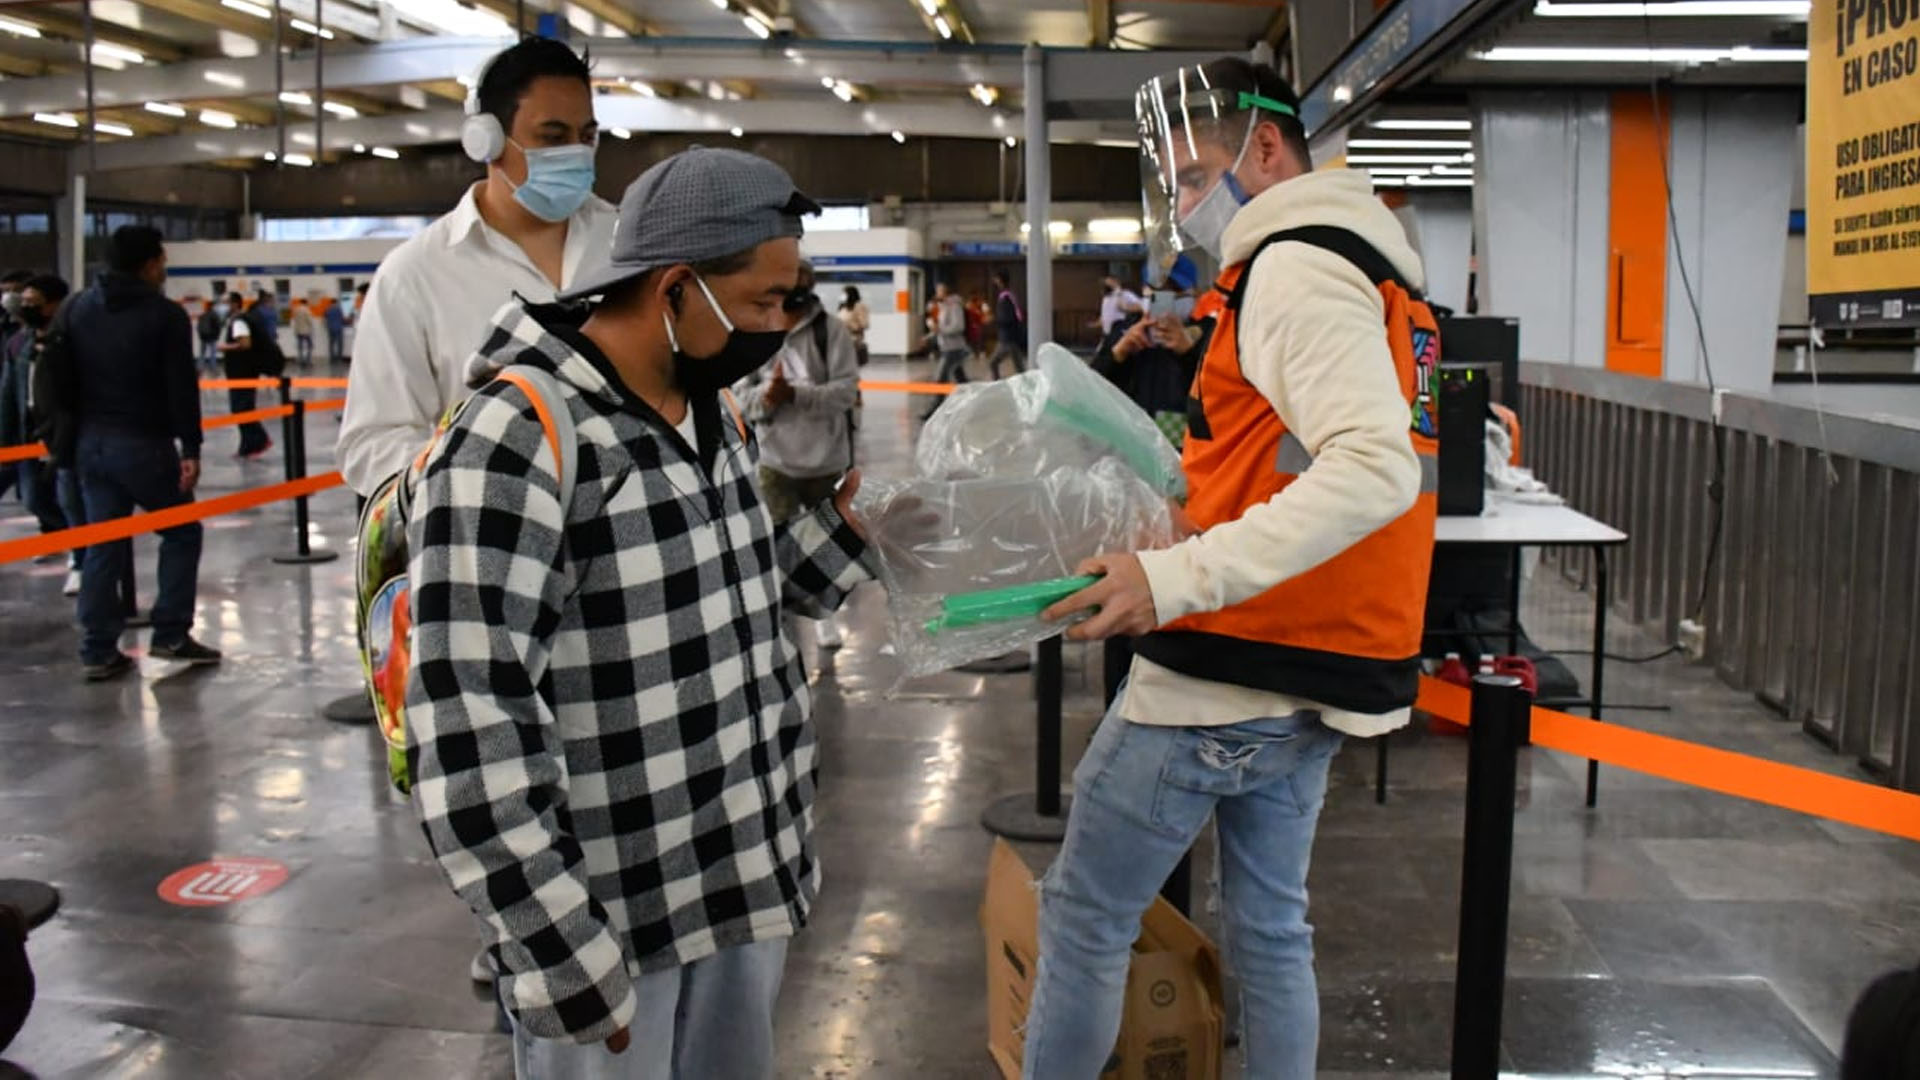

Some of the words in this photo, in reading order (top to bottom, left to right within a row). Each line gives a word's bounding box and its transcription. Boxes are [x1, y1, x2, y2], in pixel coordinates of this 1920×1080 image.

[1844, 55, 1862, 95] EN
[1867, 36, 1917, 88] CASO
[1837, 137, 1859, 167] USO
[1836, 169, 1865, 200] PARA
